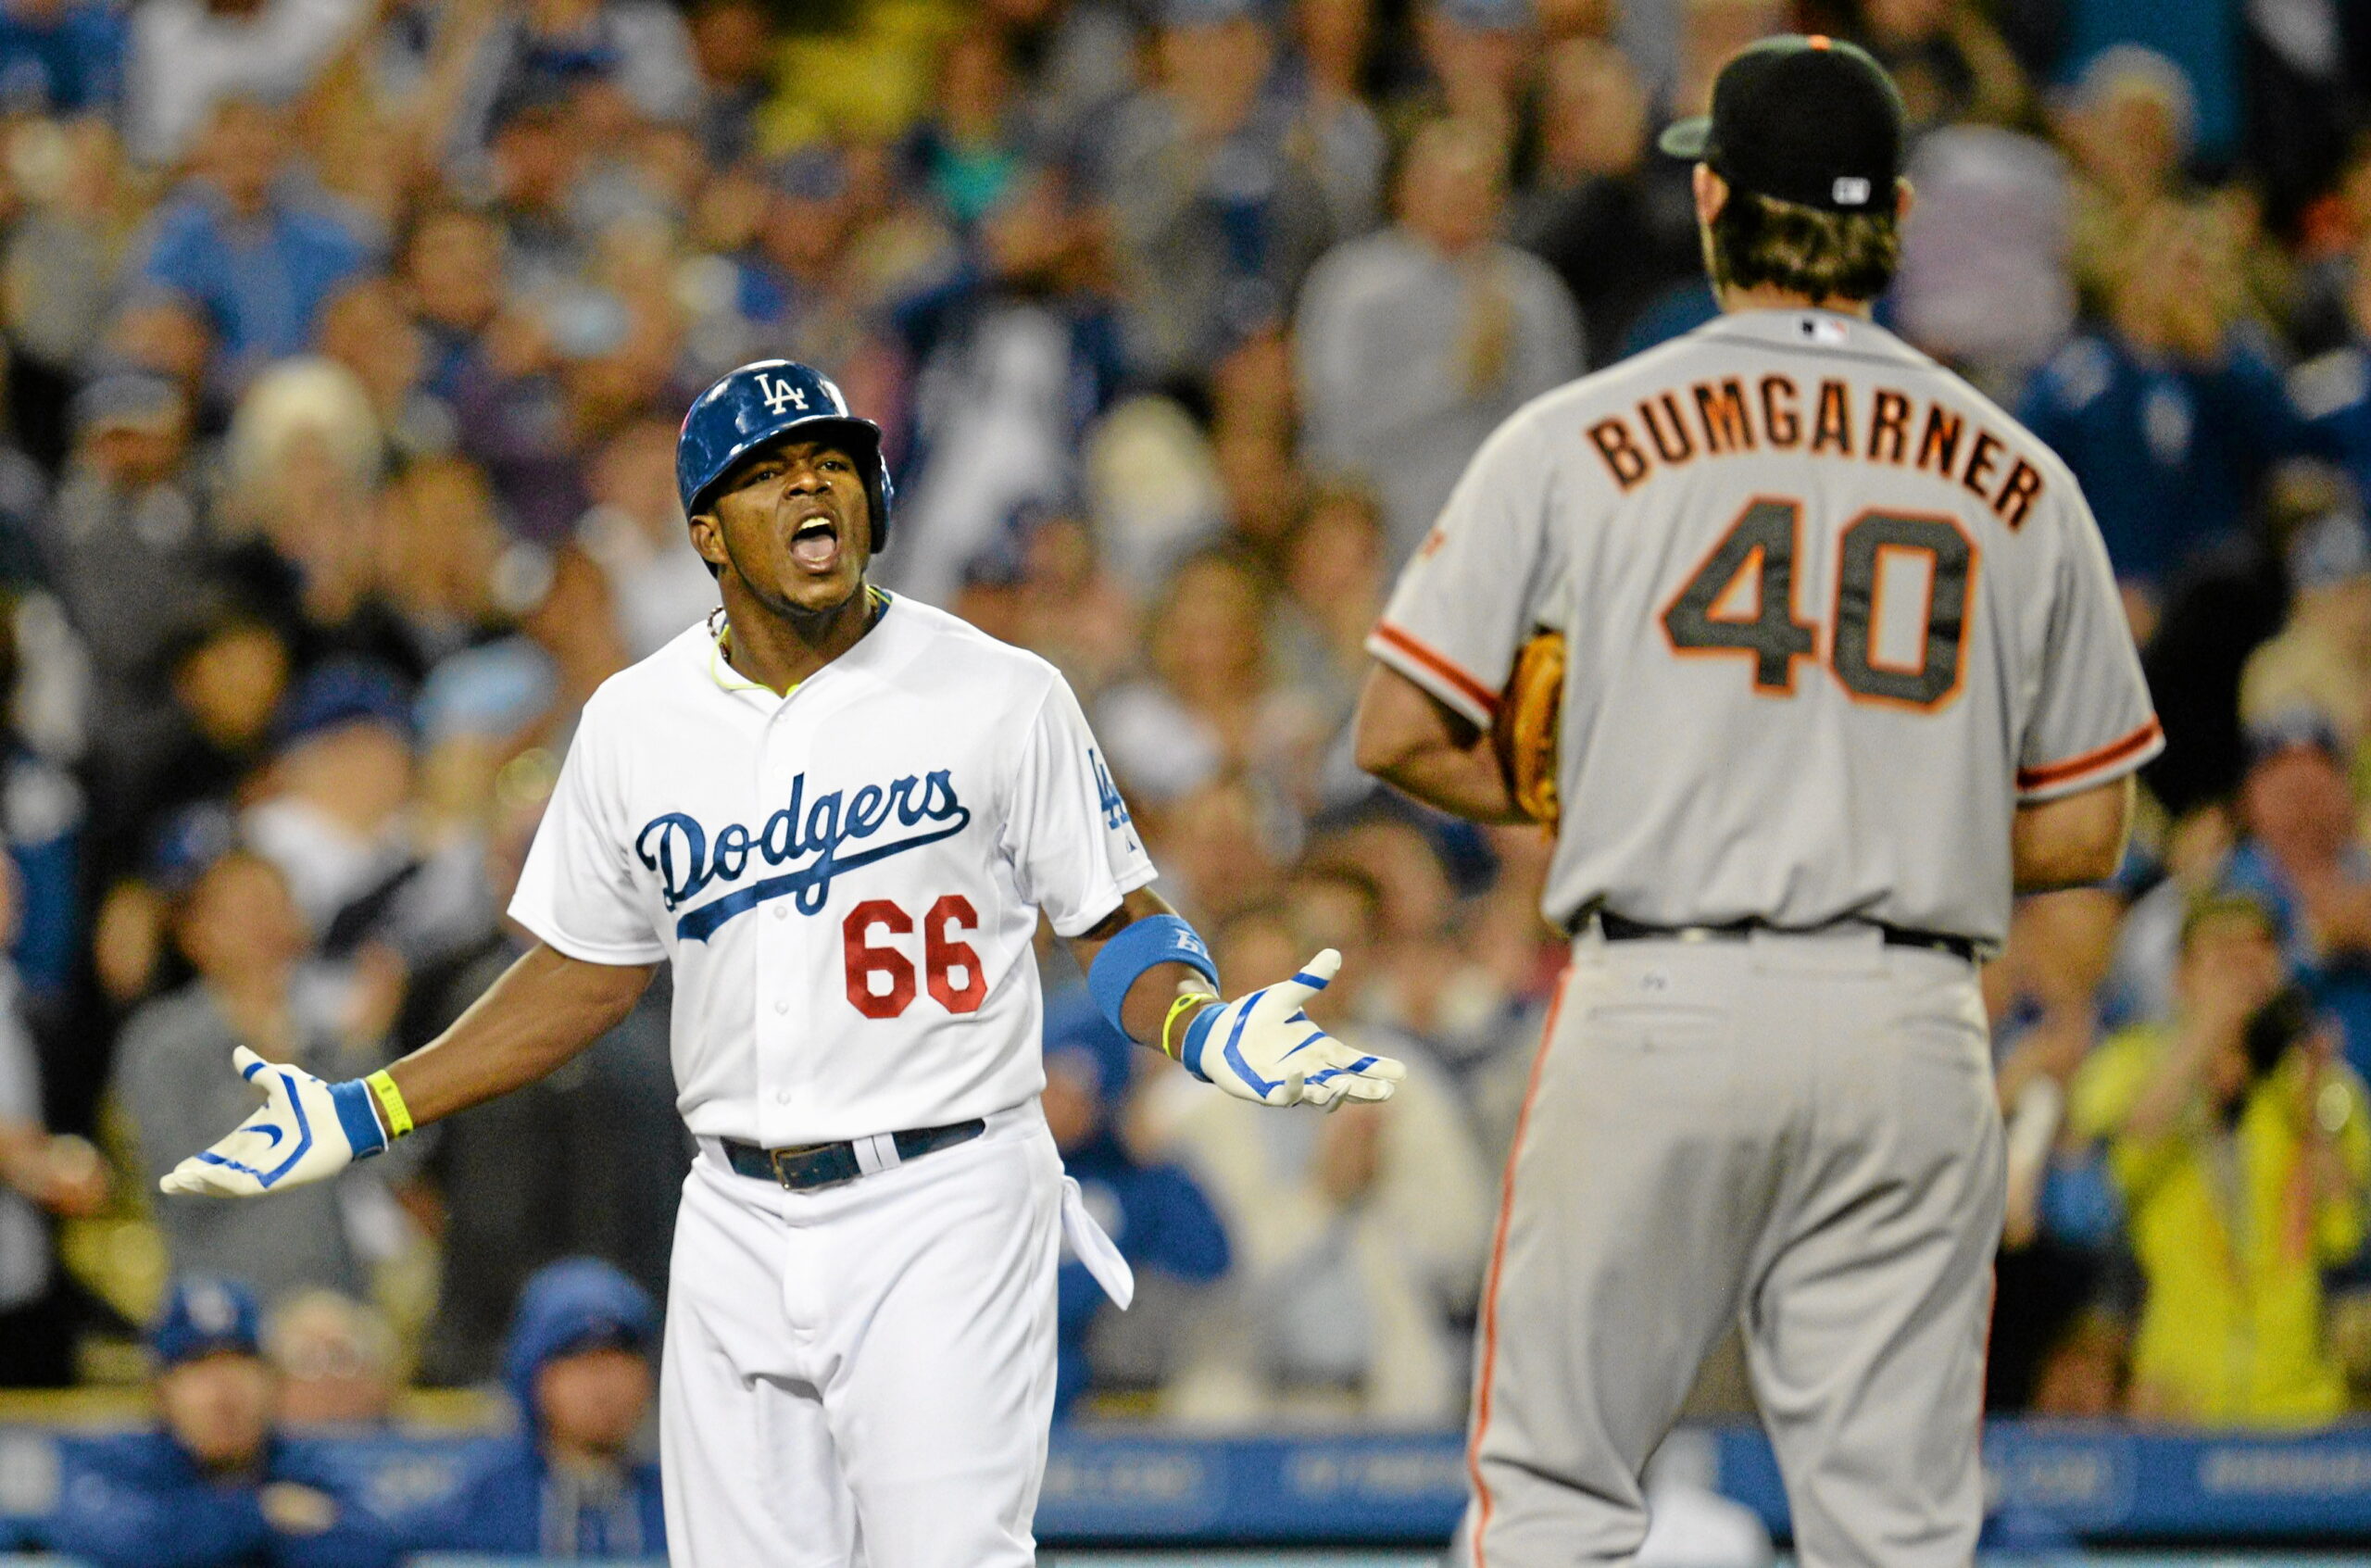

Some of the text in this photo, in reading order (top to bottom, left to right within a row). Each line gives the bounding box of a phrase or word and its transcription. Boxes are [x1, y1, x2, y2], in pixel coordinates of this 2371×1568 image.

[753, 372, 809, 416] LA
[1585, 365, 2045, 533] BUMGARNER
[1657, 494, 1980, 715] 40
[635, 769, 972, 944] Dodgers
[842, 894, 988, 1020] 66
